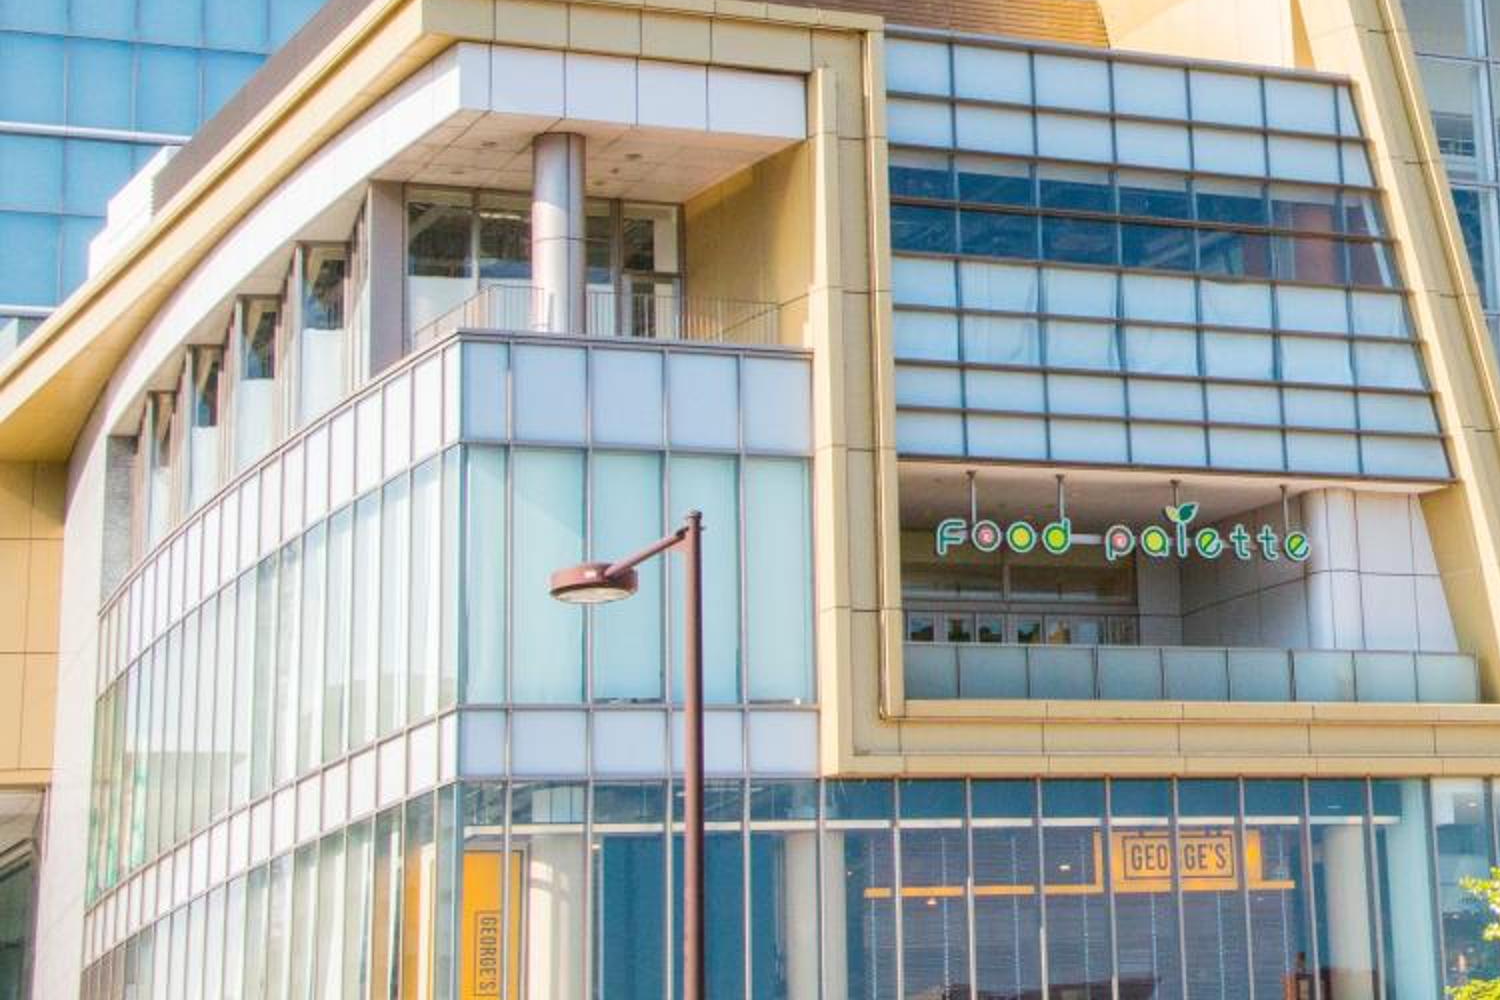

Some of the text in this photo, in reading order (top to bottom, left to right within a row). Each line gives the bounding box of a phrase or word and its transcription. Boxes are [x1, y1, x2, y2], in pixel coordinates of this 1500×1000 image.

[1104, 503, 1311, 561] palette
[1131, 842, 1226, 871] GEOGE'S
[479, 917, 498, 991] GEORGE'S
